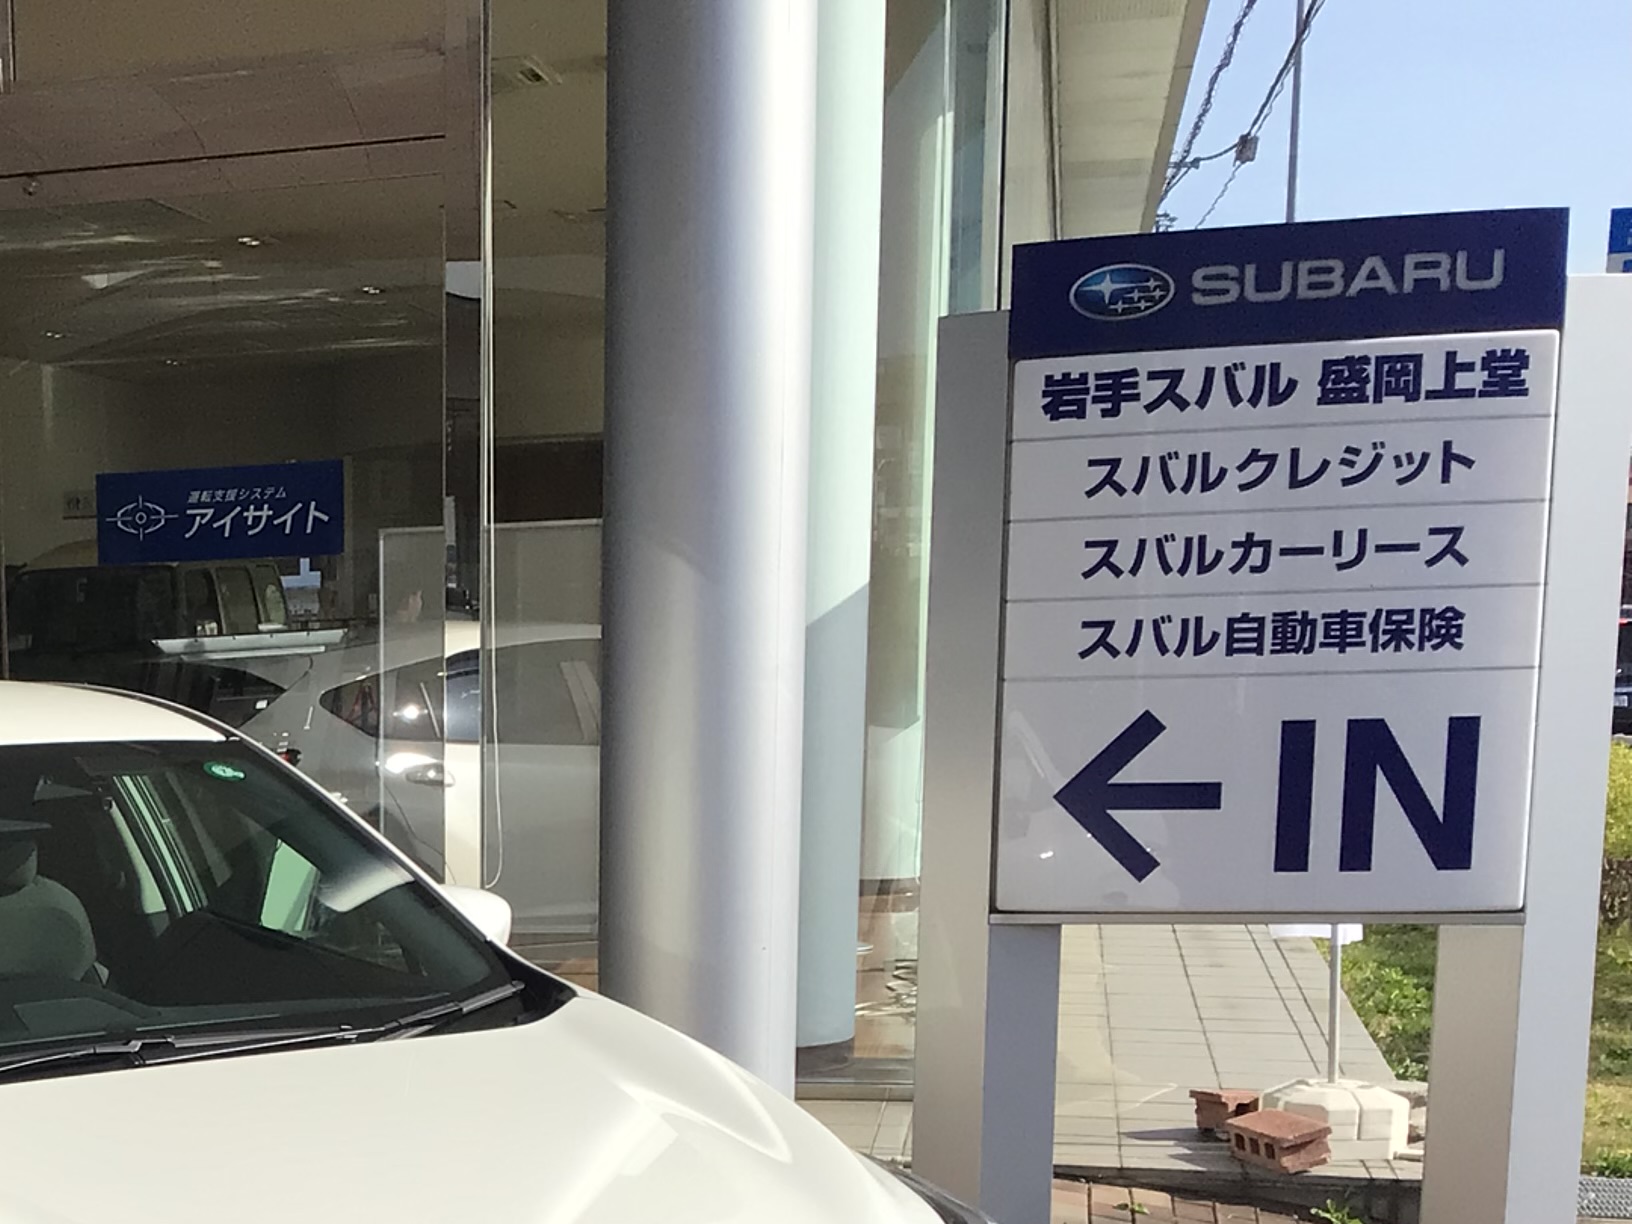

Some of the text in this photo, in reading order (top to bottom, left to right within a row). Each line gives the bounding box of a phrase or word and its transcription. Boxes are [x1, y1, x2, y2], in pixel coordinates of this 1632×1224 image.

[1191, 249, 1504, 306] SUBARU
[1041, 348, 1531, 421] 岩手スバル 盛岡上堂
[1084, 440, 1476, 498] スバルクレジット
[184, 500, 330, 540] アイサイト
[1080, 525, 1470, 580] スバルカーリース
[1077, 606, 1466, 659] スバル自動車保険
[1273, 715, 1482, 873] IN
